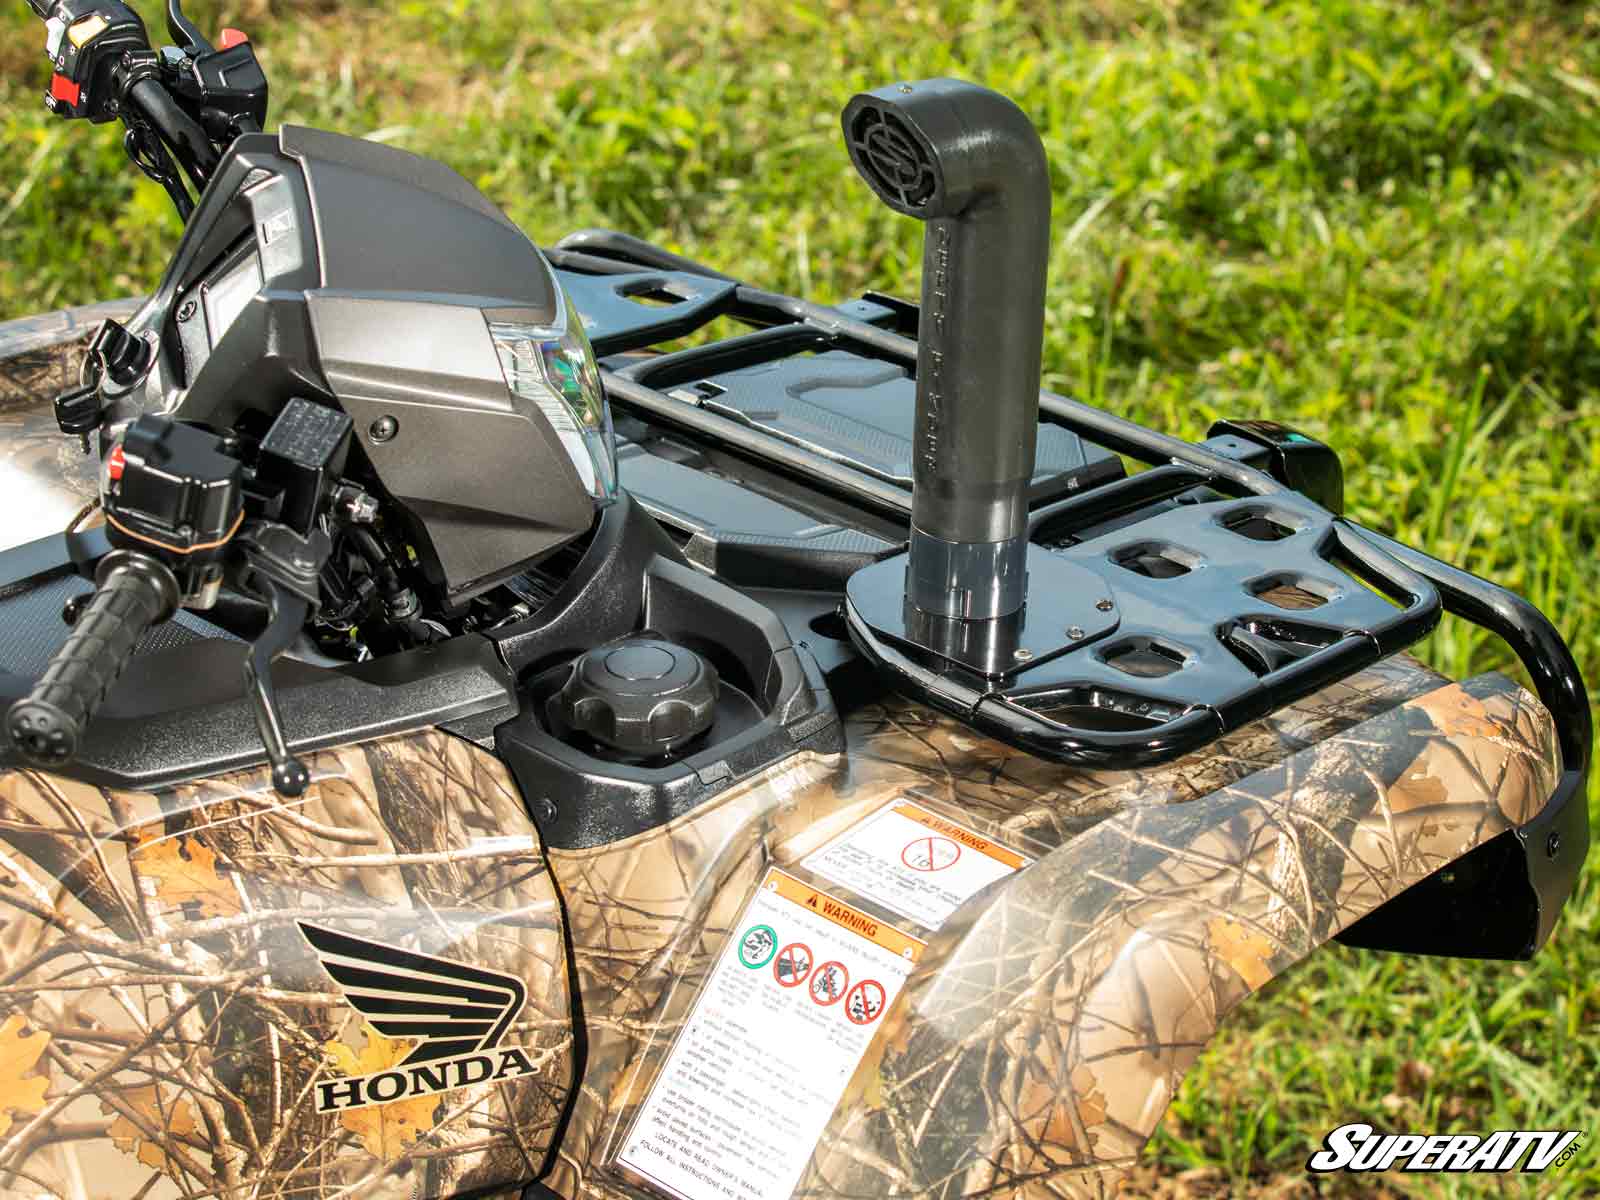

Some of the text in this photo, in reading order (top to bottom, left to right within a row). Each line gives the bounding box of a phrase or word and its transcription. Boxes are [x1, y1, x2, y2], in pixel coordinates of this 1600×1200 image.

[933, 821, 989, 849] WARNING
[823, 901, 879, 937] WARNING
[317, 1050, 538, 1111] HONDA
[640, 1139, 665, 1158] FOLLOW
[654, 1132, 678, 1149] LOCATE
[679, 1144, 692, 1157] AND
